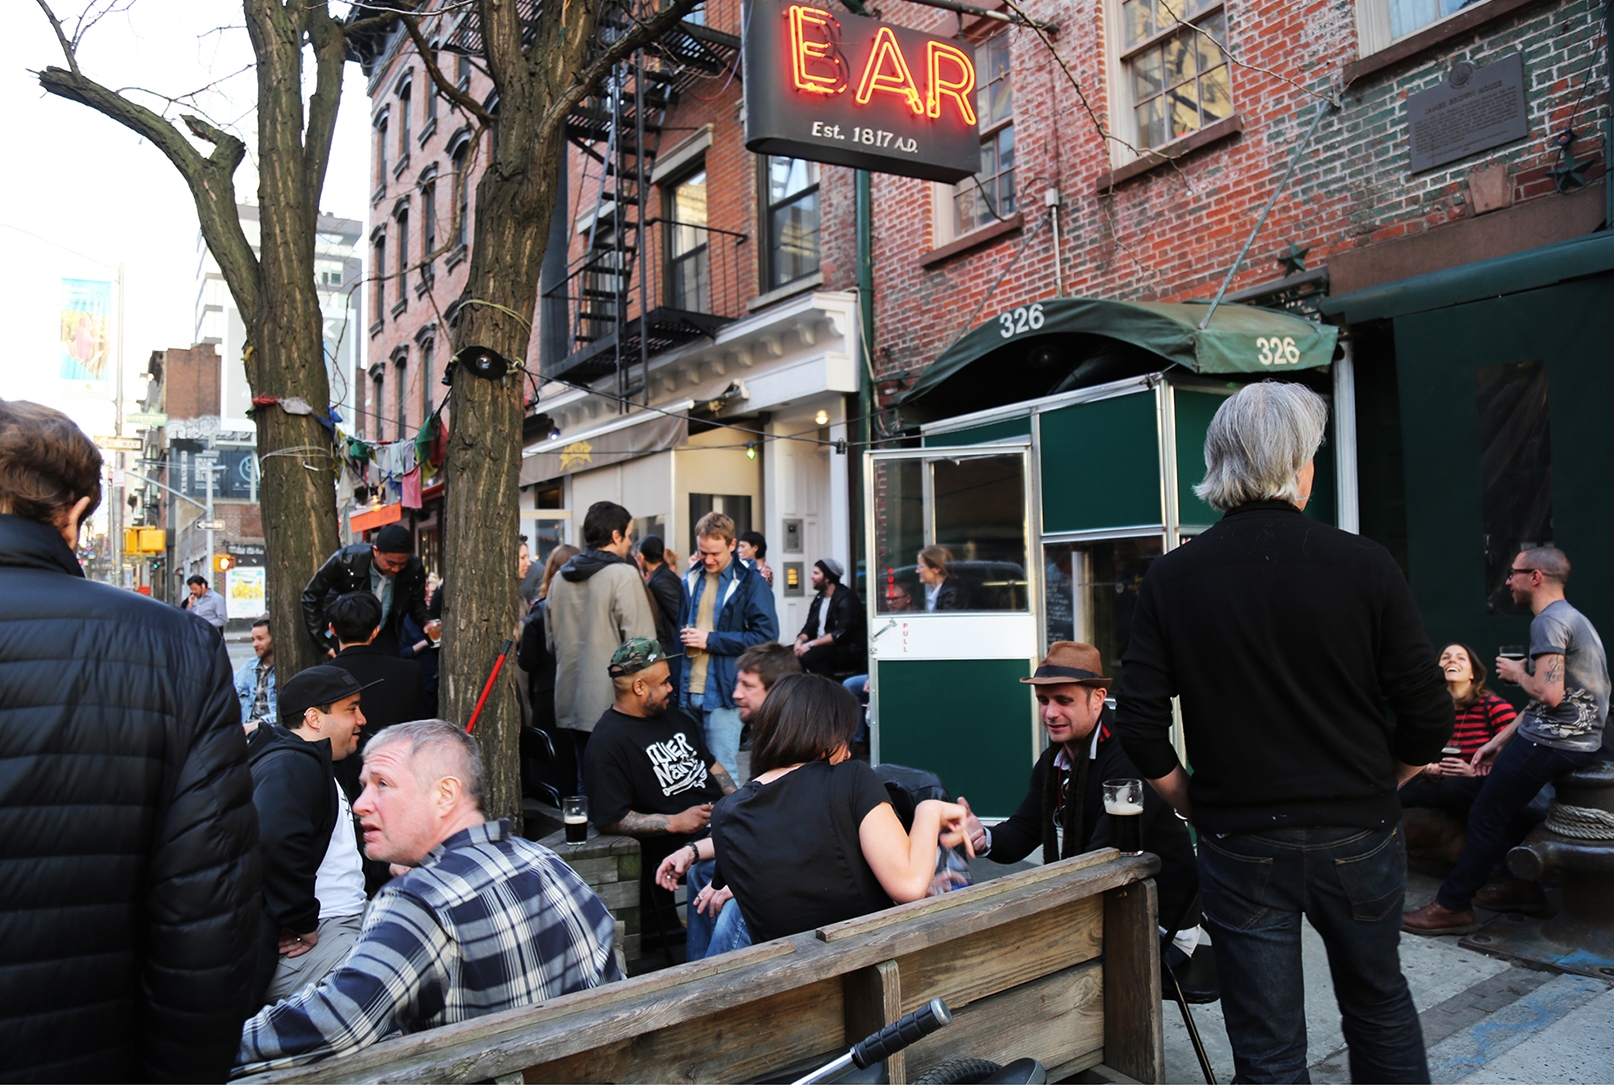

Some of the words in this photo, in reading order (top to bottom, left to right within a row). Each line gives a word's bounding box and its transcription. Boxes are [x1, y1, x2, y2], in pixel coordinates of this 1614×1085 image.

[788, 5, 977, 126] EAR
[811, 121, 845, 140] Est.
[852, 127, 894, 147] 1817
[999, 303, 1046, 339] 326
[1255, 336, 1302, 366] 326
